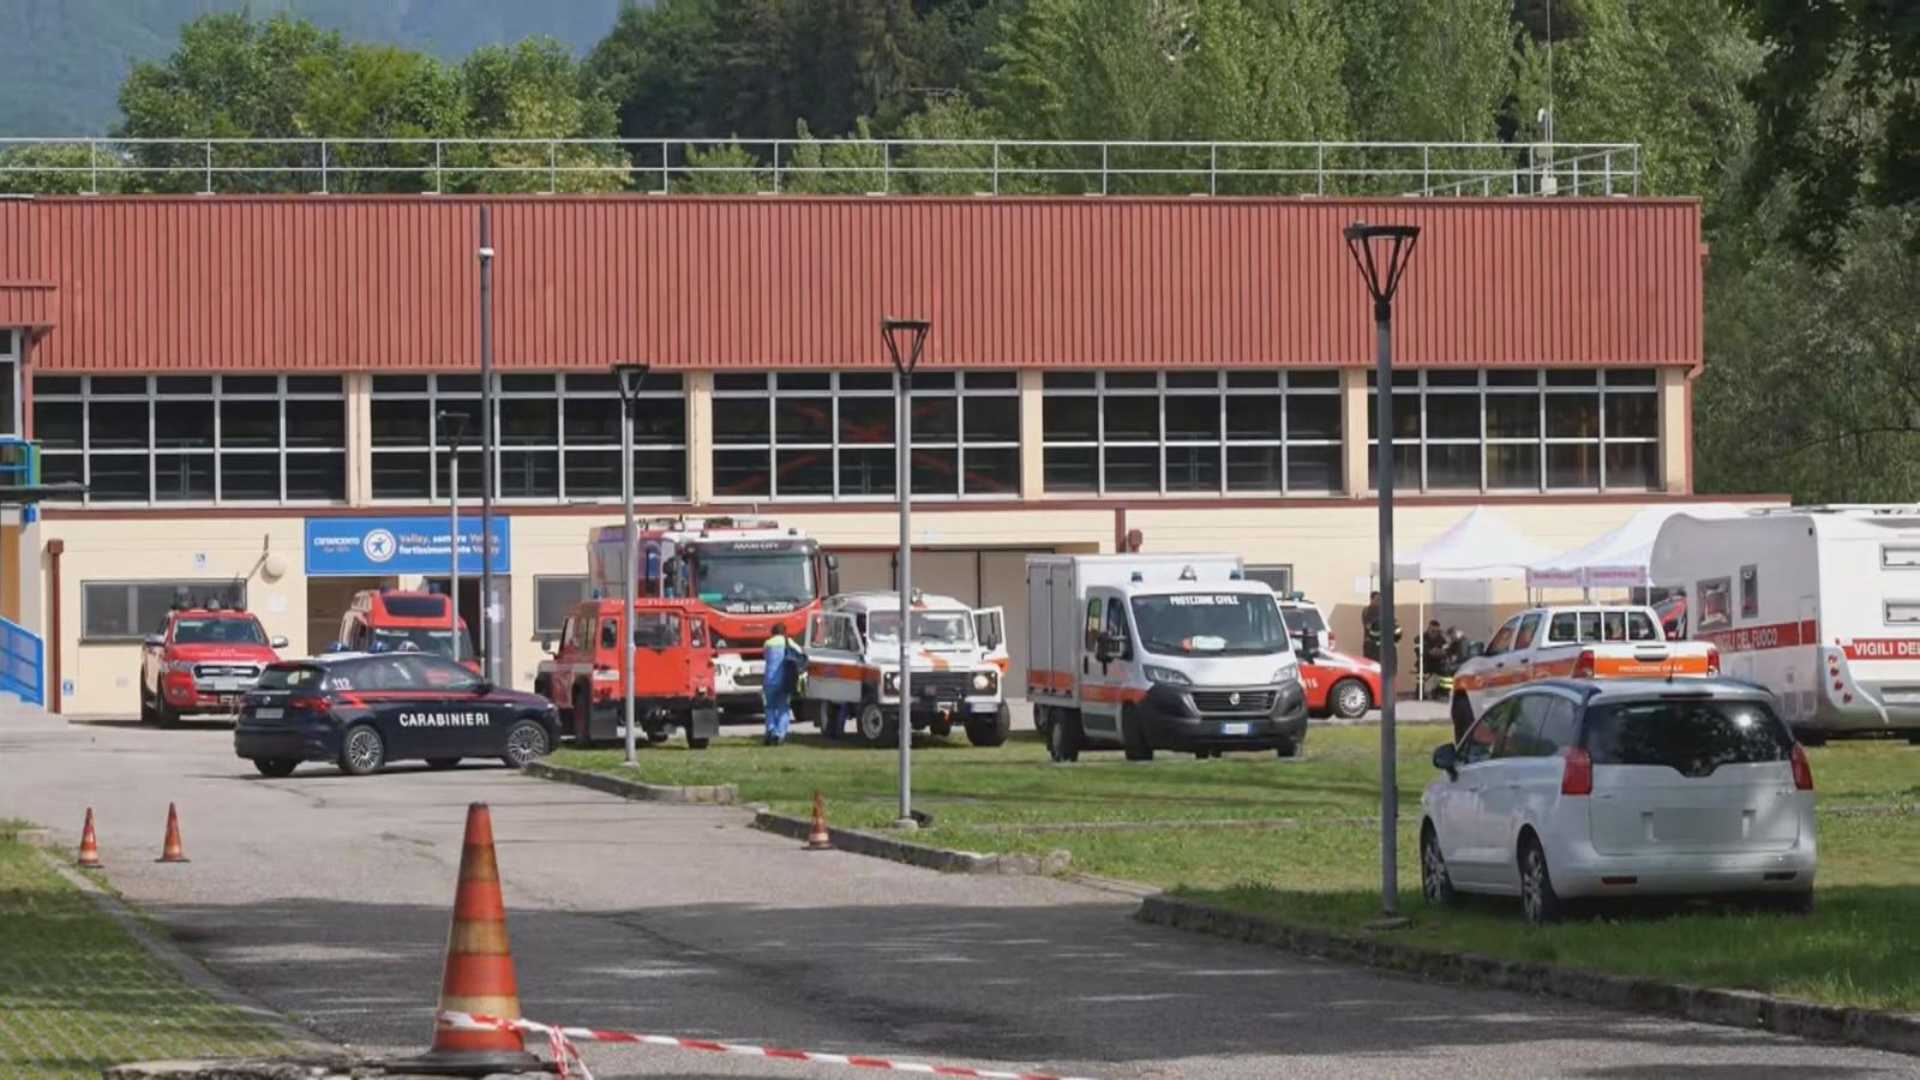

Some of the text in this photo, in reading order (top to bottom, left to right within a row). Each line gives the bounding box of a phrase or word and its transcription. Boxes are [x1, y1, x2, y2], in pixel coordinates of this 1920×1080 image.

[432, 535, 467, 543] semre
[1216, 595, 1240, 605] CIVILE
[1752, 628, 1778, 648] FUOCO
[1854, 641, 1894, 656] VIGILI
[332, 677, 354, 691] 112
[398, 712, 490, 728] CARABINIERI
